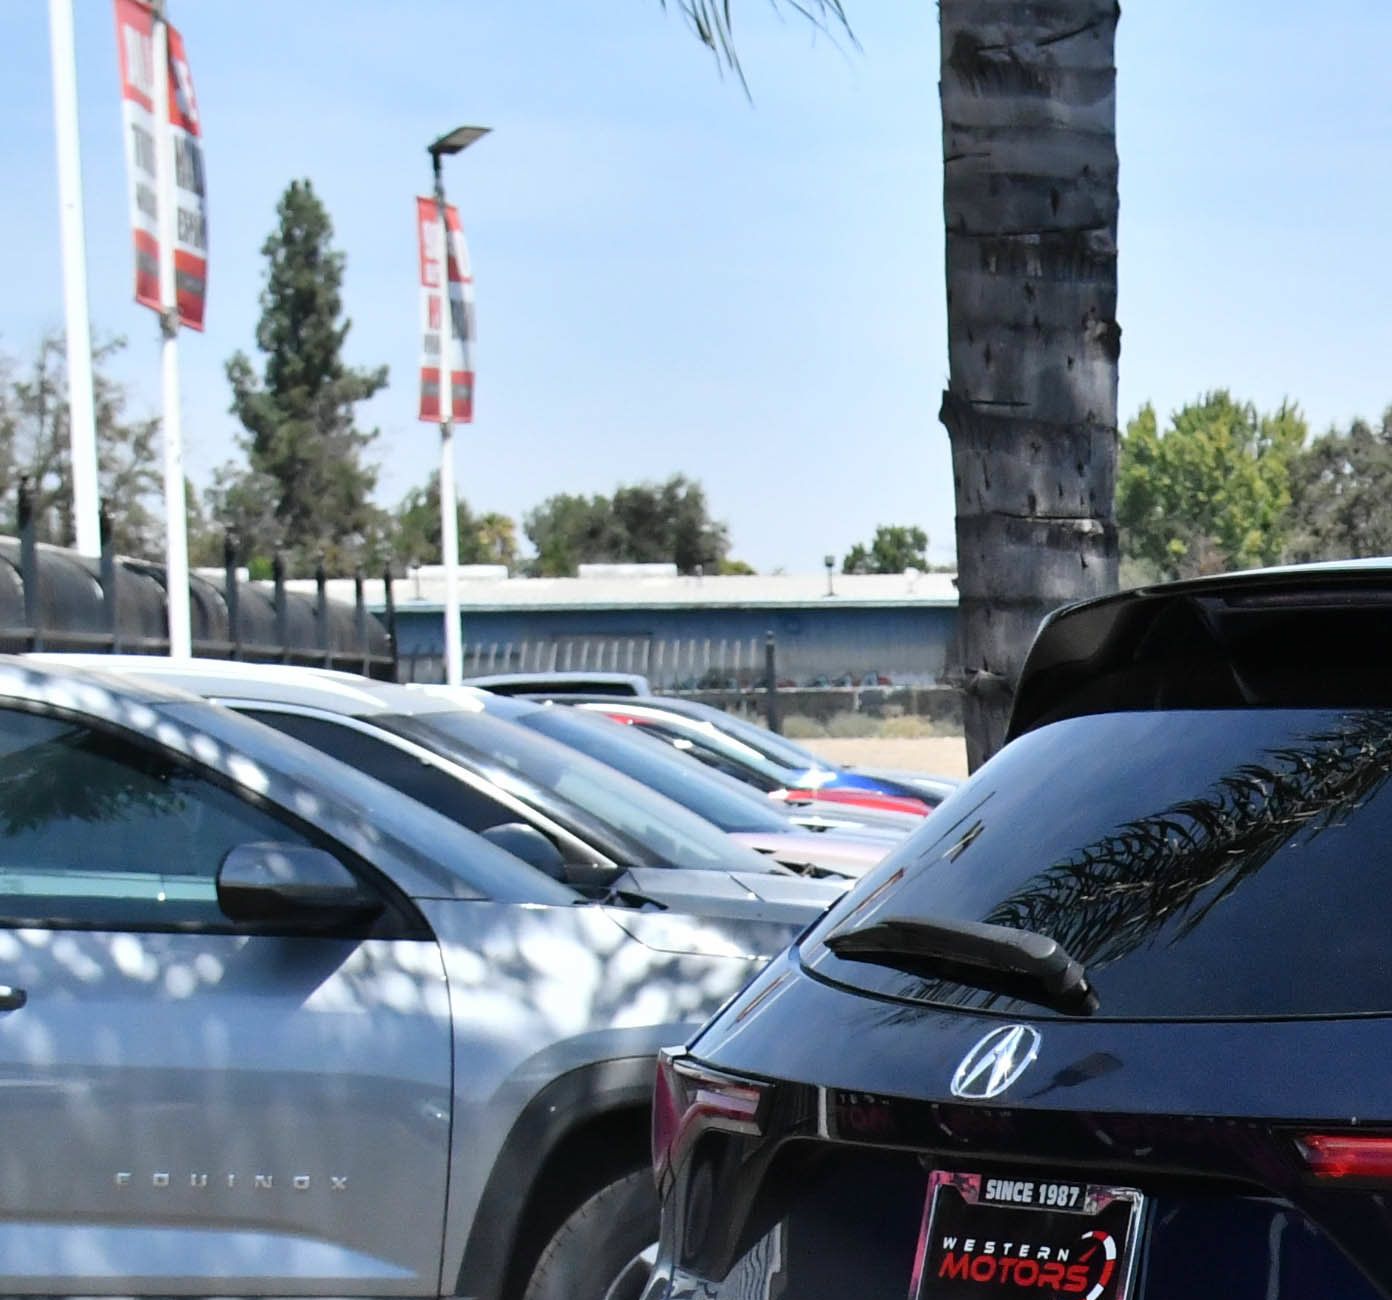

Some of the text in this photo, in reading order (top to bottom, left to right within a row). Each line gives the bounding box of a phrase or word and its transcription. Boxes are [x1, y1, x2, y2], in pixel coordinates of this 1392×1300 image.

[116, 1172, 348, 1190] EQUINOX
[985, 1179, 1080, 1208] SINCE 1987
[943, 1236, 1070, 1262] WESTERN
[938, 1252, 1089, 1293] MOTORS
